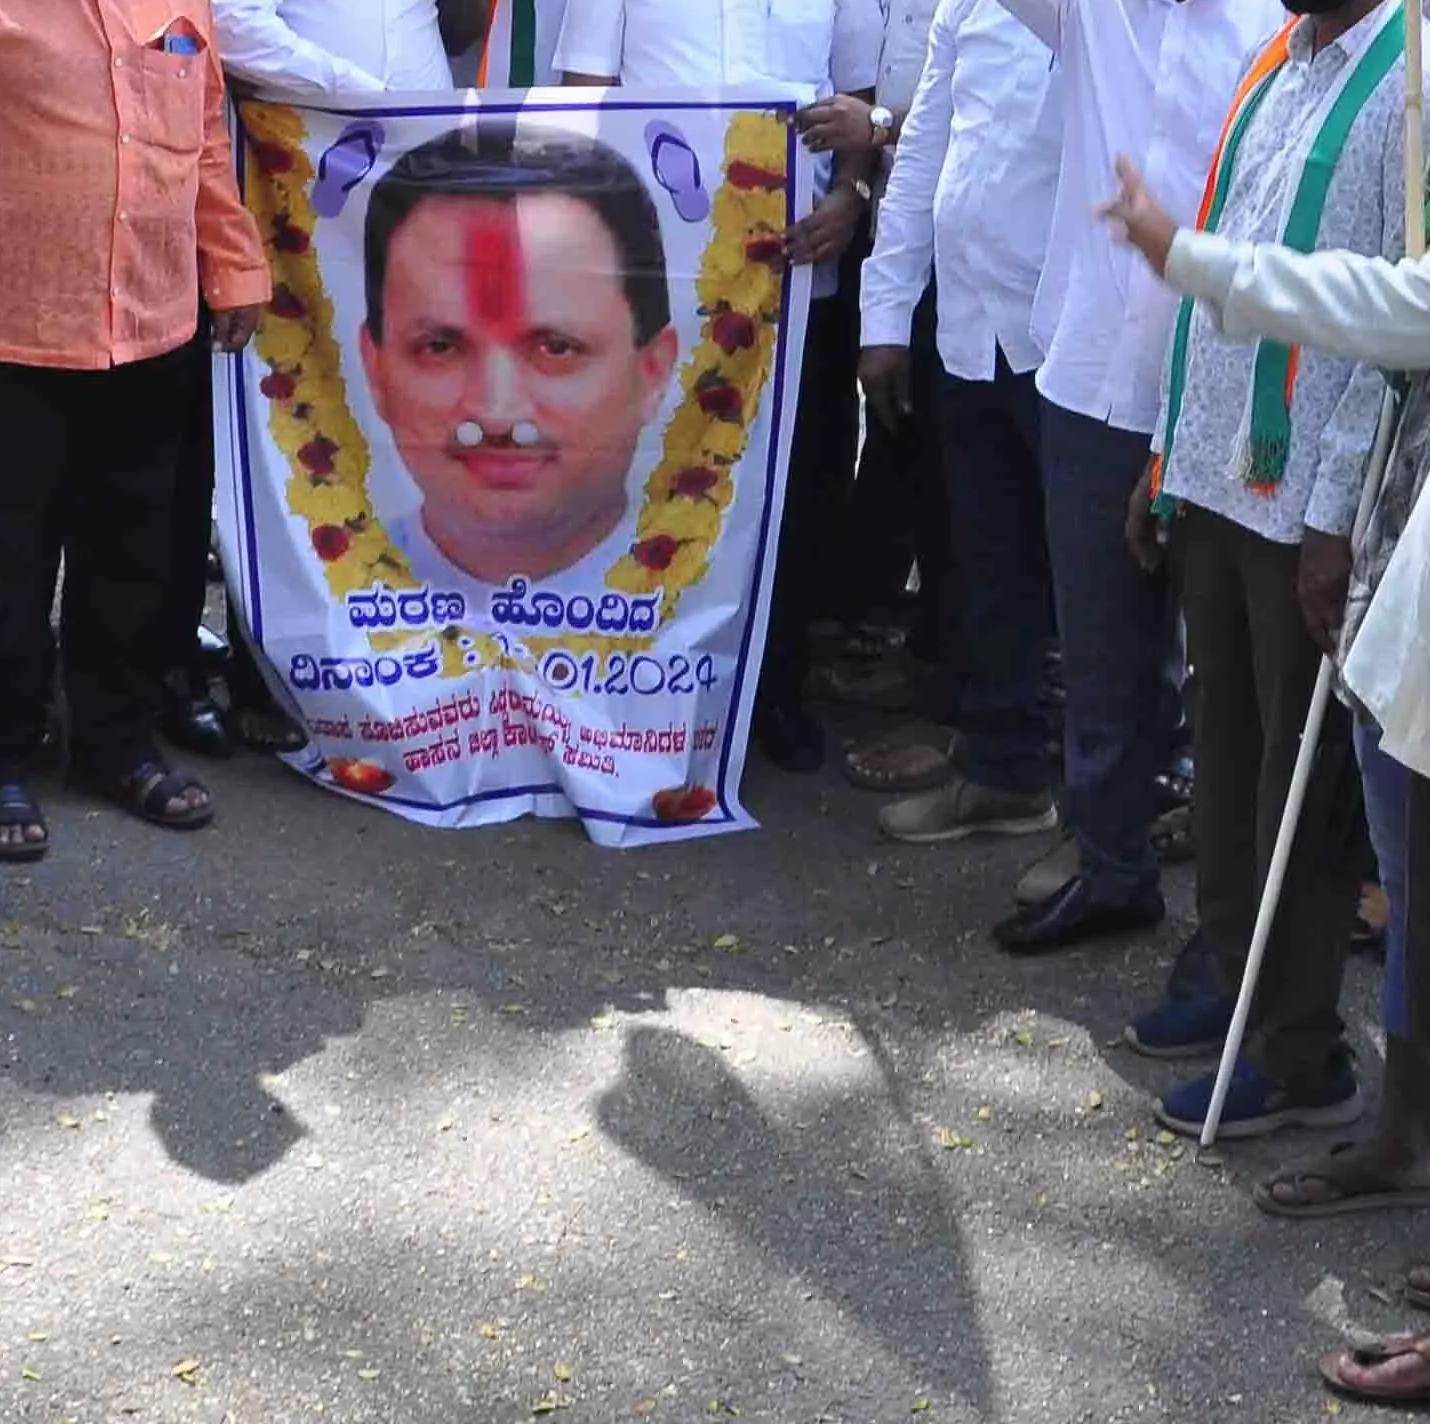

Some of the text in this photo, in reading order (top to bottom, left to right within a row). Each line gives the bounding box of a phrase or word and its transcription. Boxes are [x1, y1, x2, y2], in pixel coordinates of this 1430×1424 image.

[347, 578, 662, 630] ಮರಣ ಹೊಂದಿದ
[289, 648, 440, 692] ದಿನಾಂಕ
